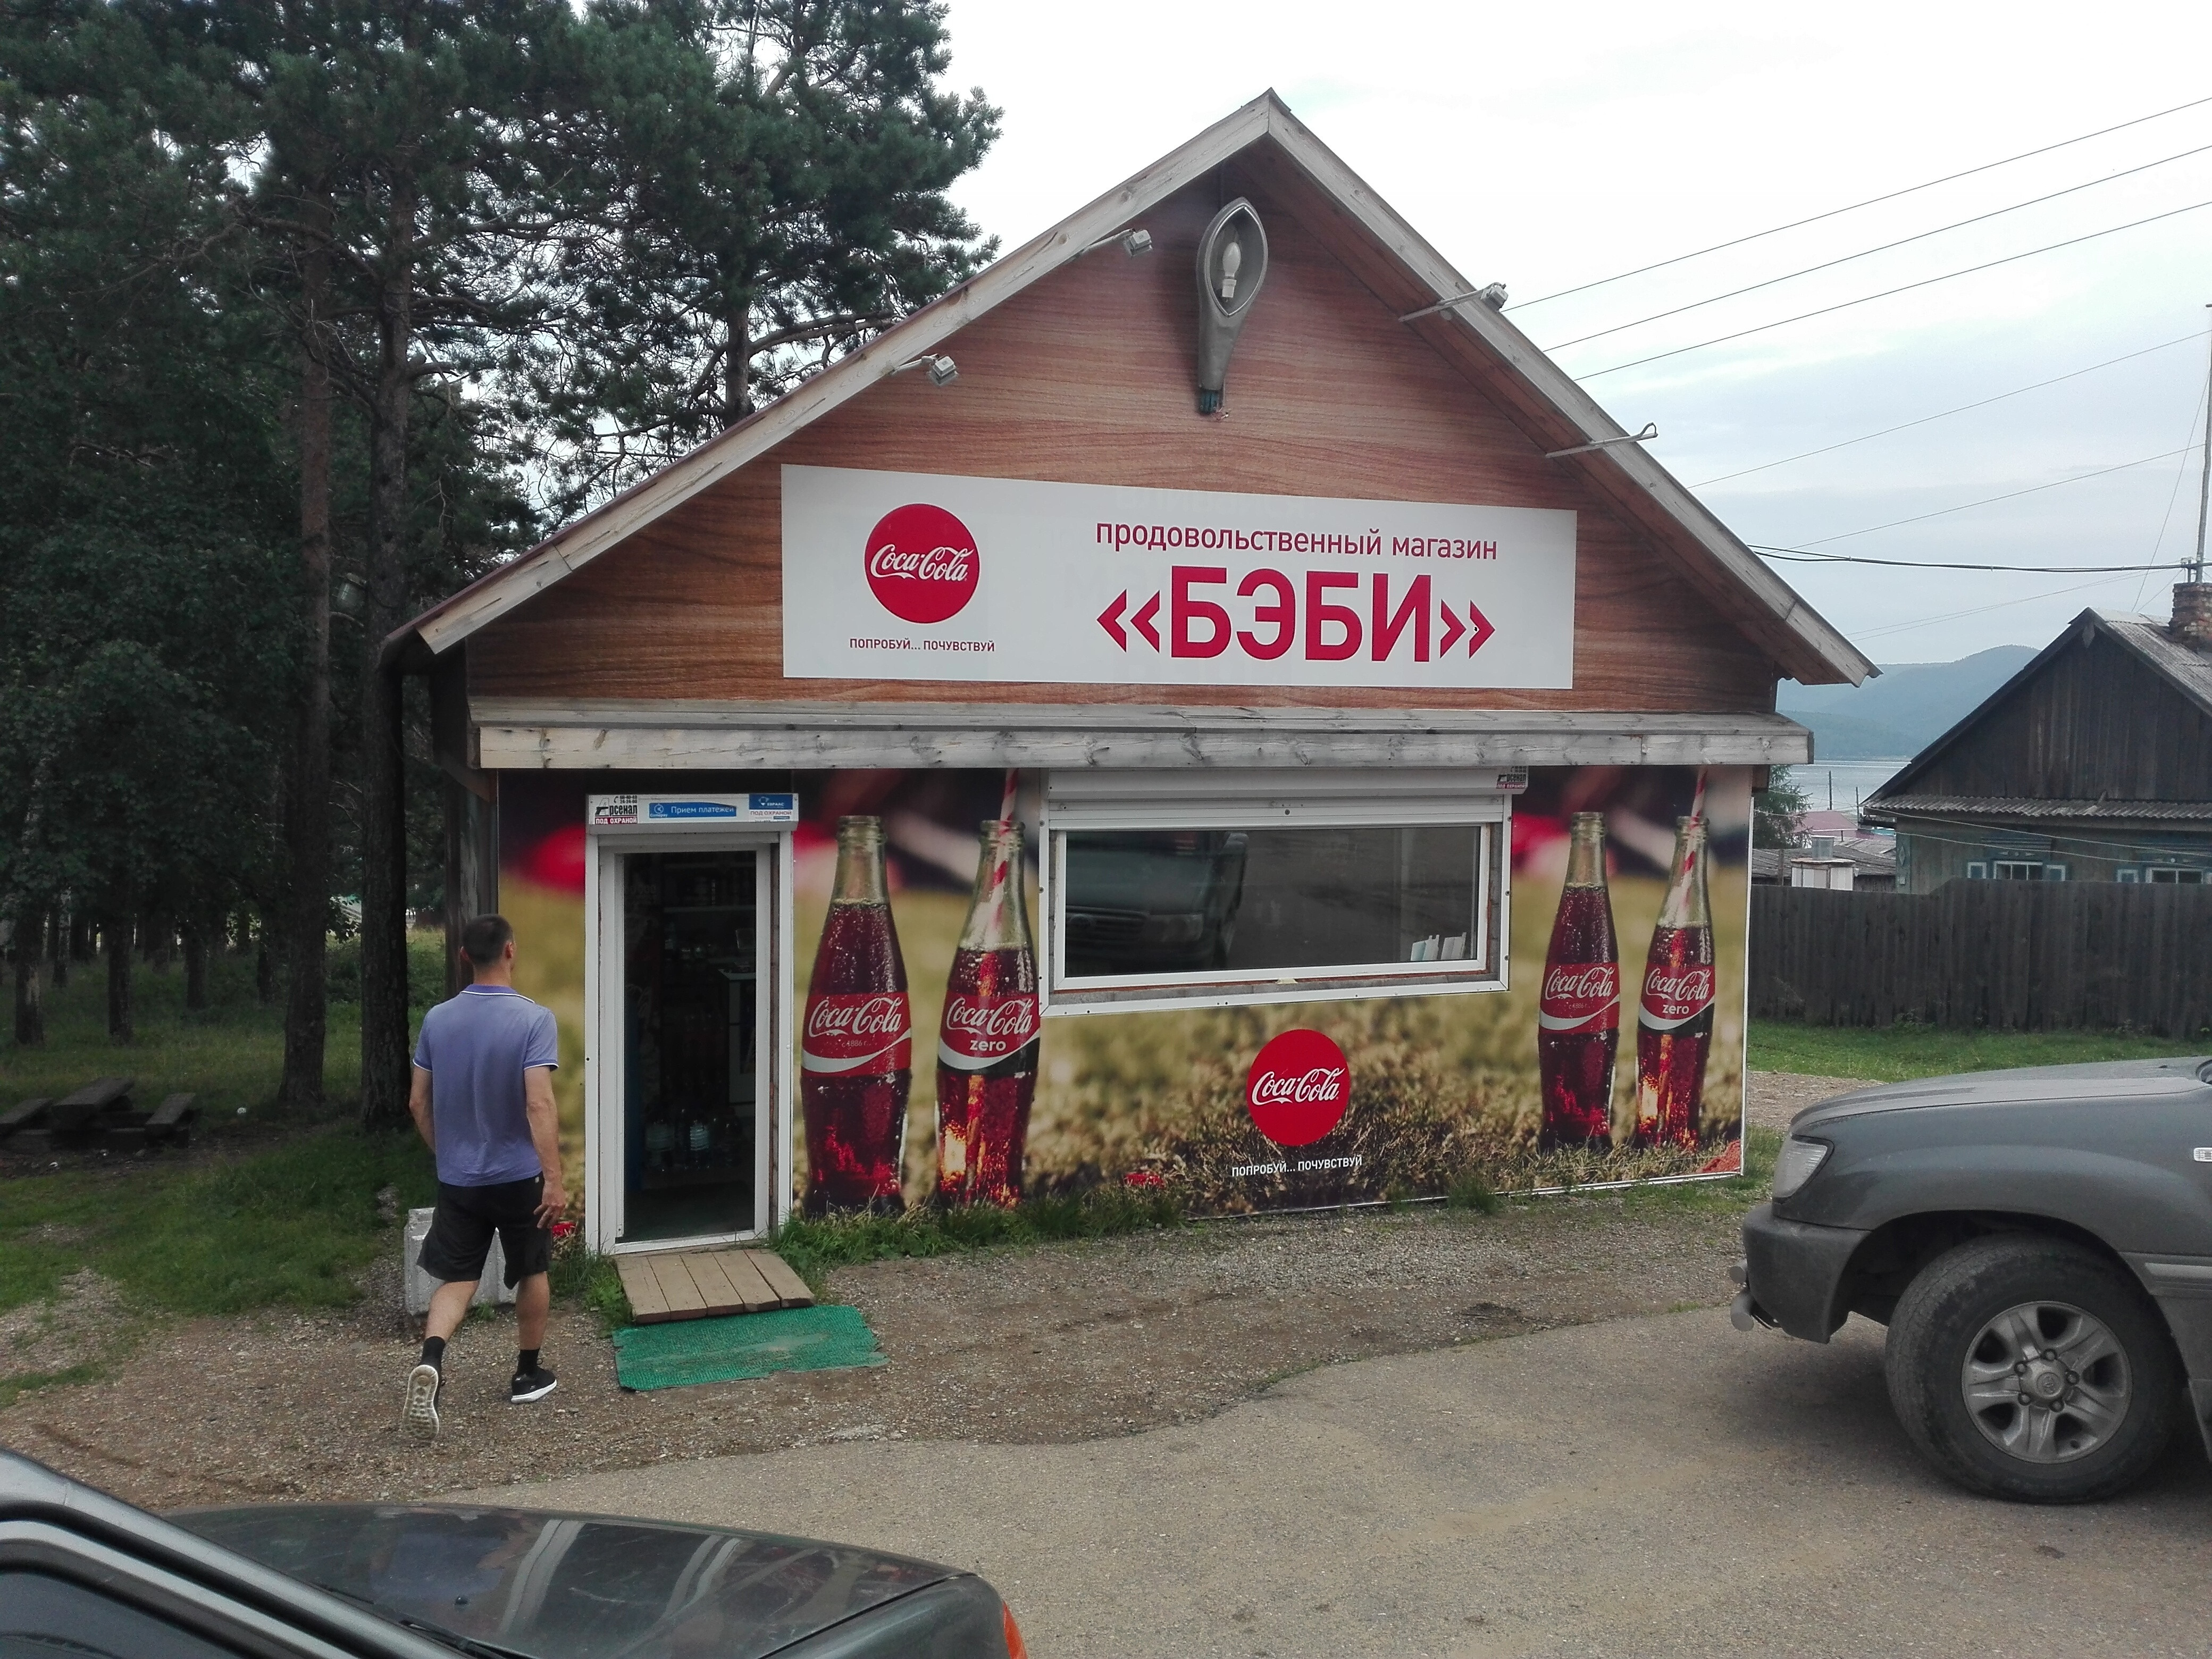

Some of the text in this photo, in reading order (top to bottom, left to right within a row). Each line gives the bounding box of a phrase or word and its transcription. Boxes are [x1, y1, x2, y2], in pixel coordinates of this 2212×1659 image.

[1096, 522, 1497, 558] продовольственный магазин
[870, 543, 975, 582] Coca-Cola
[850, 638, 995, 652] ПОПРОБУЙ... ПОЧУВСТВУЙ
[1497, 773, 1526, 783] рсенал
[1545, 967, 1615, 1000] Coca-Cola
[1646, 967, 1712, 1001] Coca-Cola
[808, 996, 902, 1037] Coca-Cola
[946, 996, 1035, 1036] Coca-Cola
[1662, 1004, 1690, 1015] zero
[969, 1040, 1007, 1052] zero
[1252, 1067, 1346, 1106] Coca-Cola
[1231, 1154, 1362, 1177] ПОПРОБУЙ... ПОЧУВСТВУЙ
